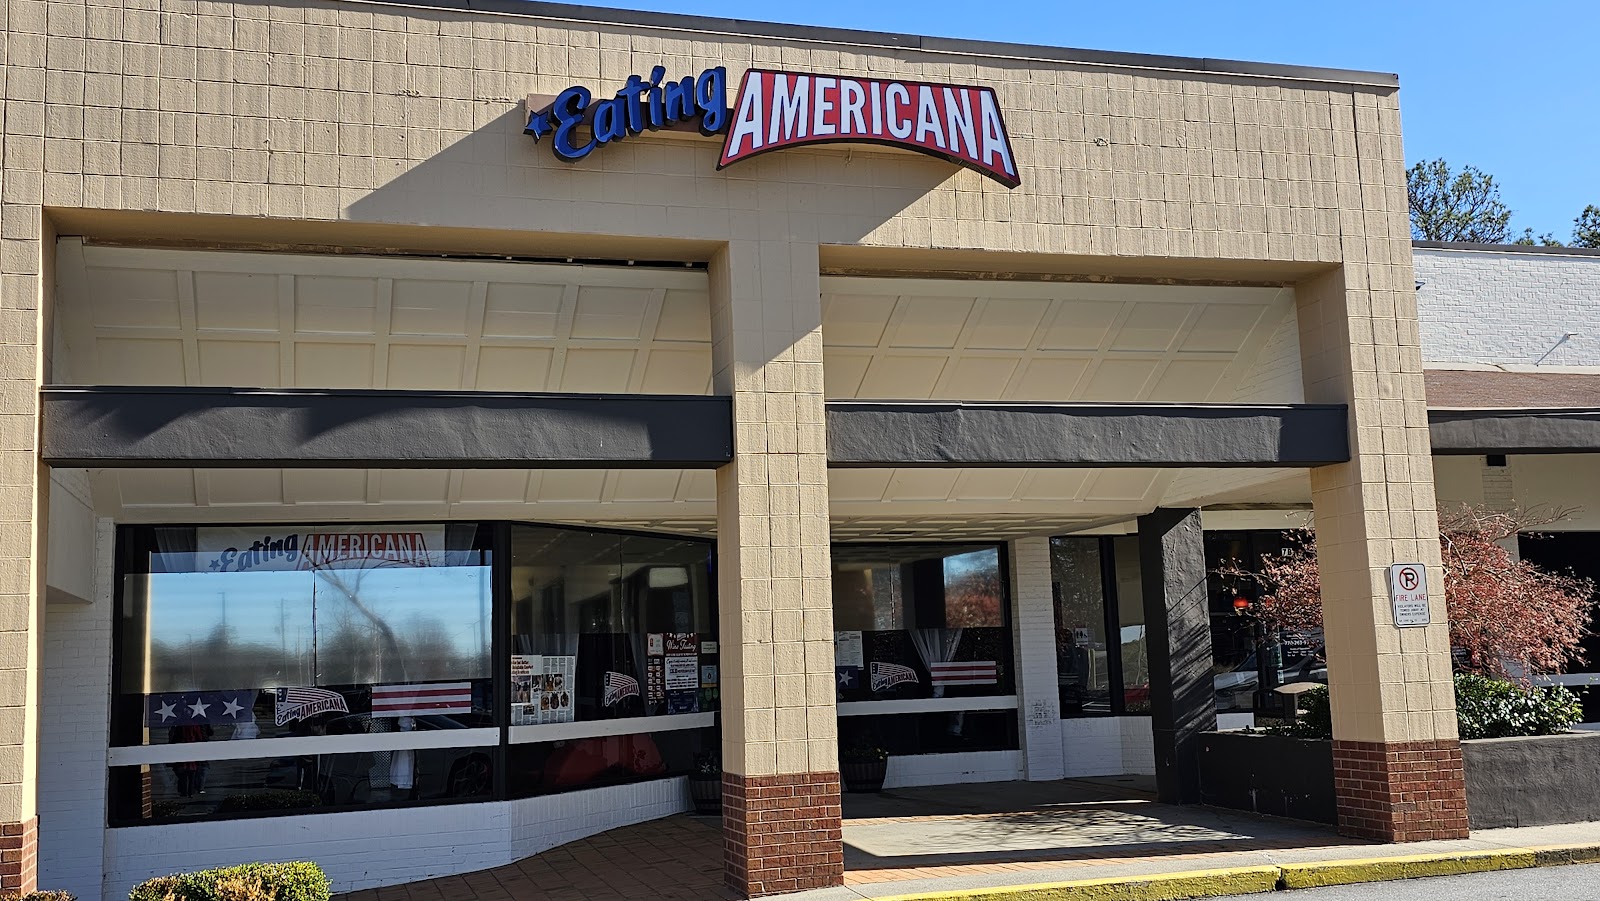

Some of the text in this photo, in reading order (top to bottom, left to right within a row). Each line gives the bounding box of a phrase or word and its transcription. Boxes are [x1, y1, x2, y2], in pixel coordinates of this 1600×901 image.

[552, 65, 1015, 177] Eating AMERICANA
[219, 533, 430, 572] Eating AMERICANA
[1411, 593, 1426, 601] LANE
[300, 697, 347, 718] AMERICANA
